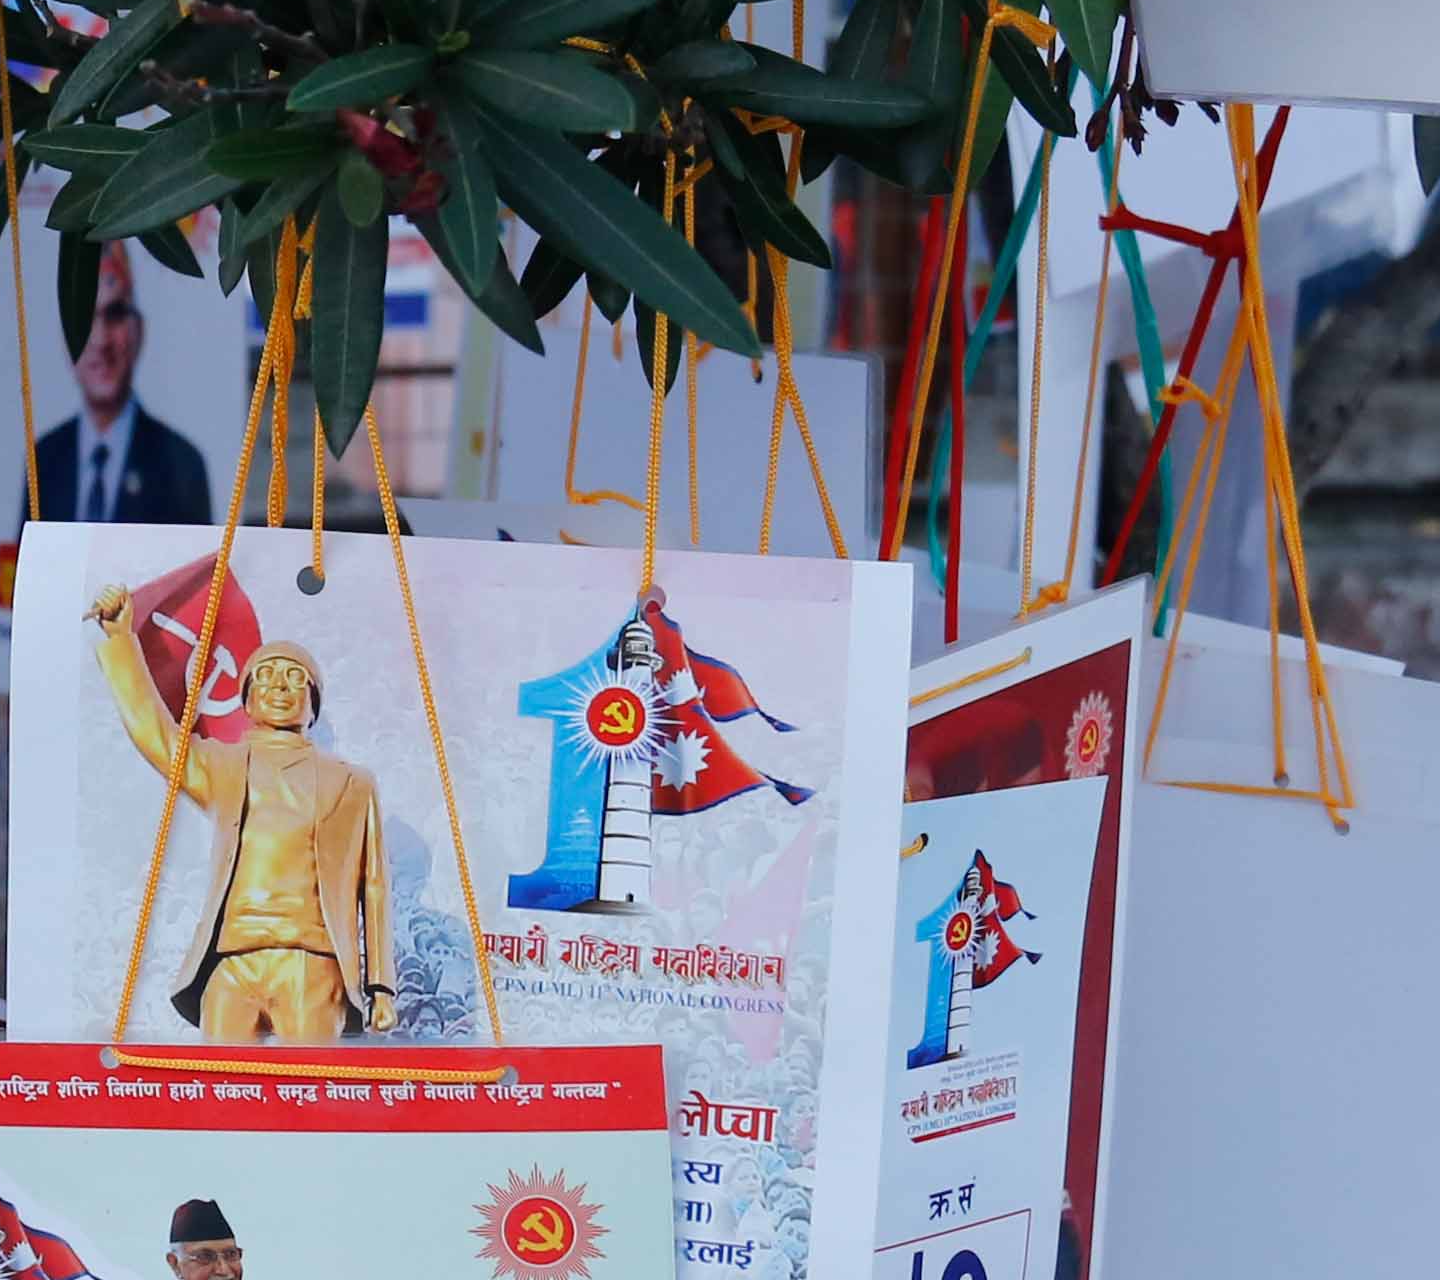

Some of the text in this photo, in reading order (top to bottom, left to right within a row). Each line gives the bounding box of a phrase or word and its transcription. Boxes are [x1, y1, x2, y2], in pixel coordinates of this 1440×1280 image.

[493, 976, 527, 991] CPN
[532, 978, 583, 997] (UML)
[616, 988, 697, 1008] NATIONAL
[699, 994, 785, 1015] CONGRESS
[57, 1077, 98, 1097] शक्ति
[106, 1077, 161, 1098] निर्माण
[168, 1079, 205, 1100] हाम्रो
[214, 1079, 267, 1103] संकल्प,
[277, 1083, 318, 1105] समृद्ध
[326, 1080, 371, 1100] नेपाल
[379, 1080, 416, 1105] सुखी
[424, 1081, 476, 1101] नेपाली
[683, 1239, 755, 1269] रलाई
